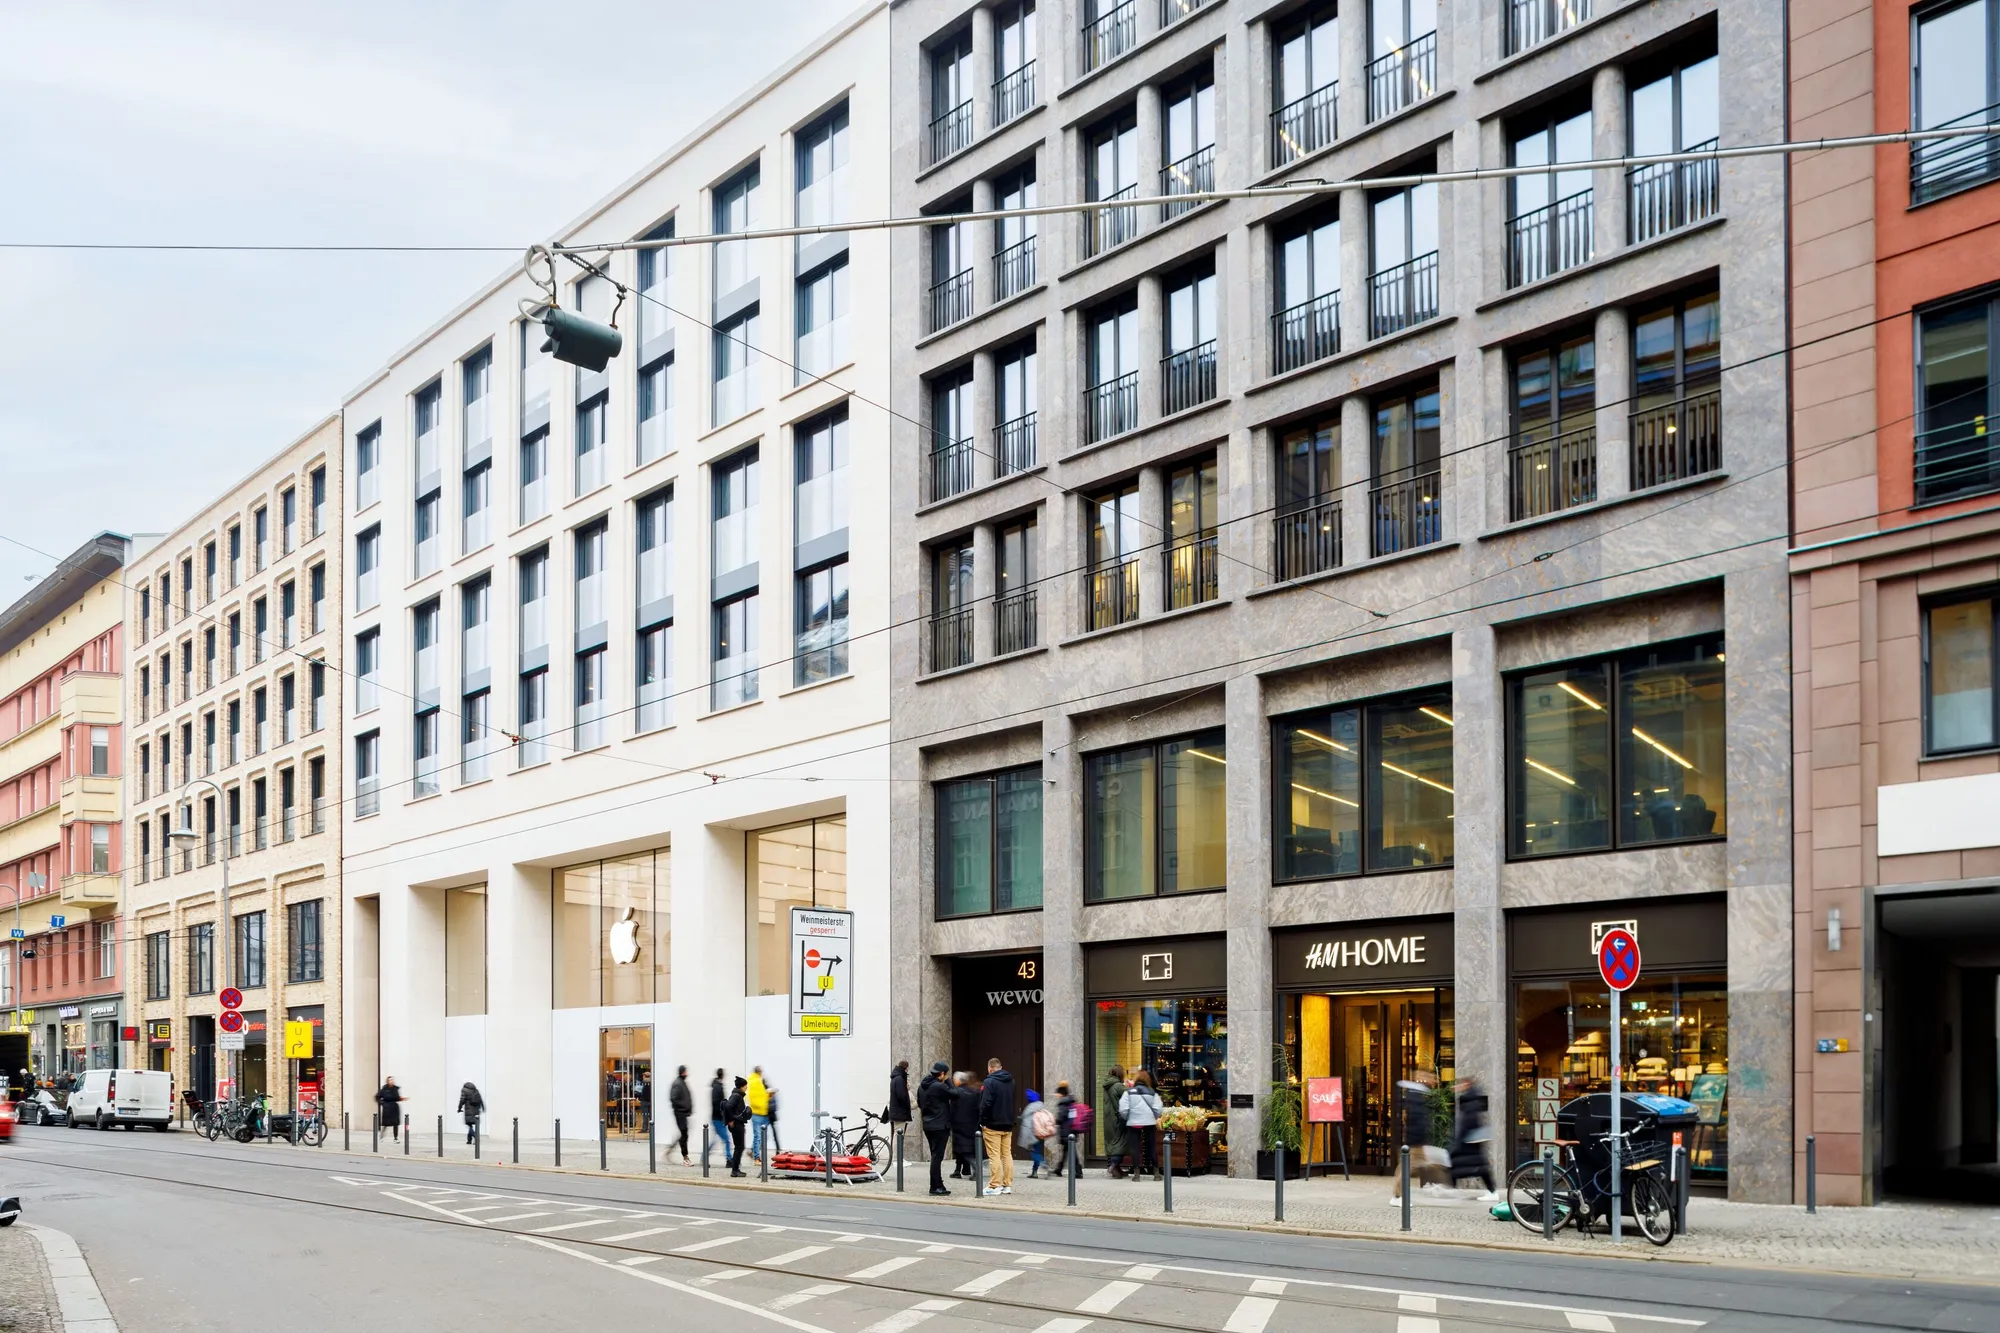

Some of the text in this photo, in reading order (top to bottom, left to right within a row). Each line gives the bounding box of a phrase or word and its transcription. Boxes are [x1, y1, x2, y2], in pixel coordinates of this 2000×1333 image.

[54, 916, 63, 927] T
[800, 913, 846, 926] Weinmeisterstr.
[13, 930, 23, 938] W
[809, 926, 836, 935] gesperrt
[1305, 936, 1426, 970] H&M HOME
[1017, 960, 1036, 979] 43
[822, 977, 830, 988] U
[985, 988, 1045, 1006] wewo
[803, 1020, 839, 1030] Umleitung
[294, 1027, 303, 1036] U
[1541, 1079, 1558, 1160] SAL
